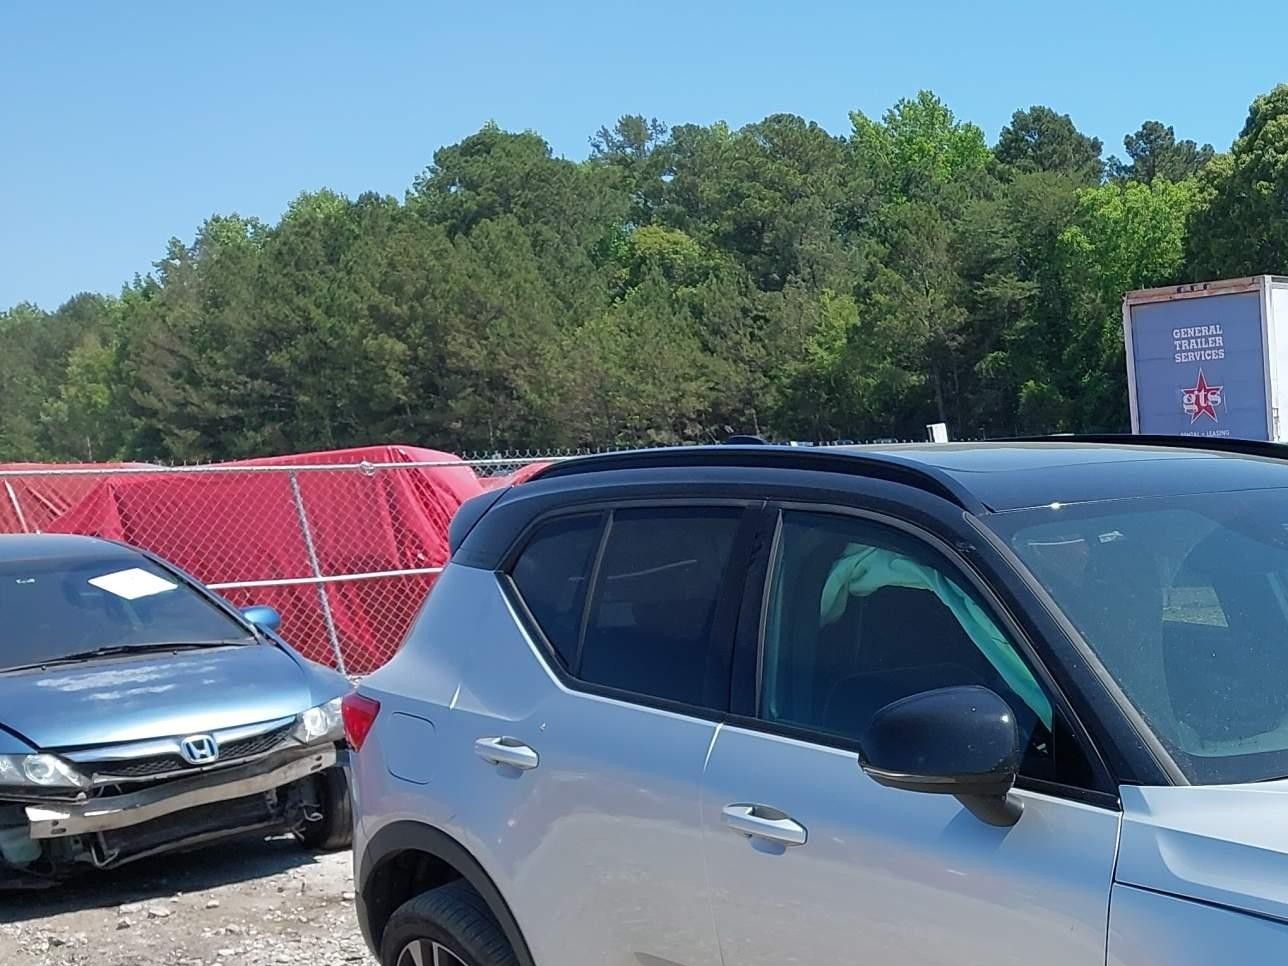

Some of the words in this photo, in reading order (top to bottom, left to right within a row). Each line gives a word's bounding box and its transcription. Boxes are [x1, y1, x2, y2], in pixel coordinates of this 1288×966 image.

[1172, 324, 1223, 338] GENERAL
[1173, 336, 1224, 350] TRAILER
[1174, 349, 1225, 363] SERVICES
[1182, 389, 1222, 415] gts
